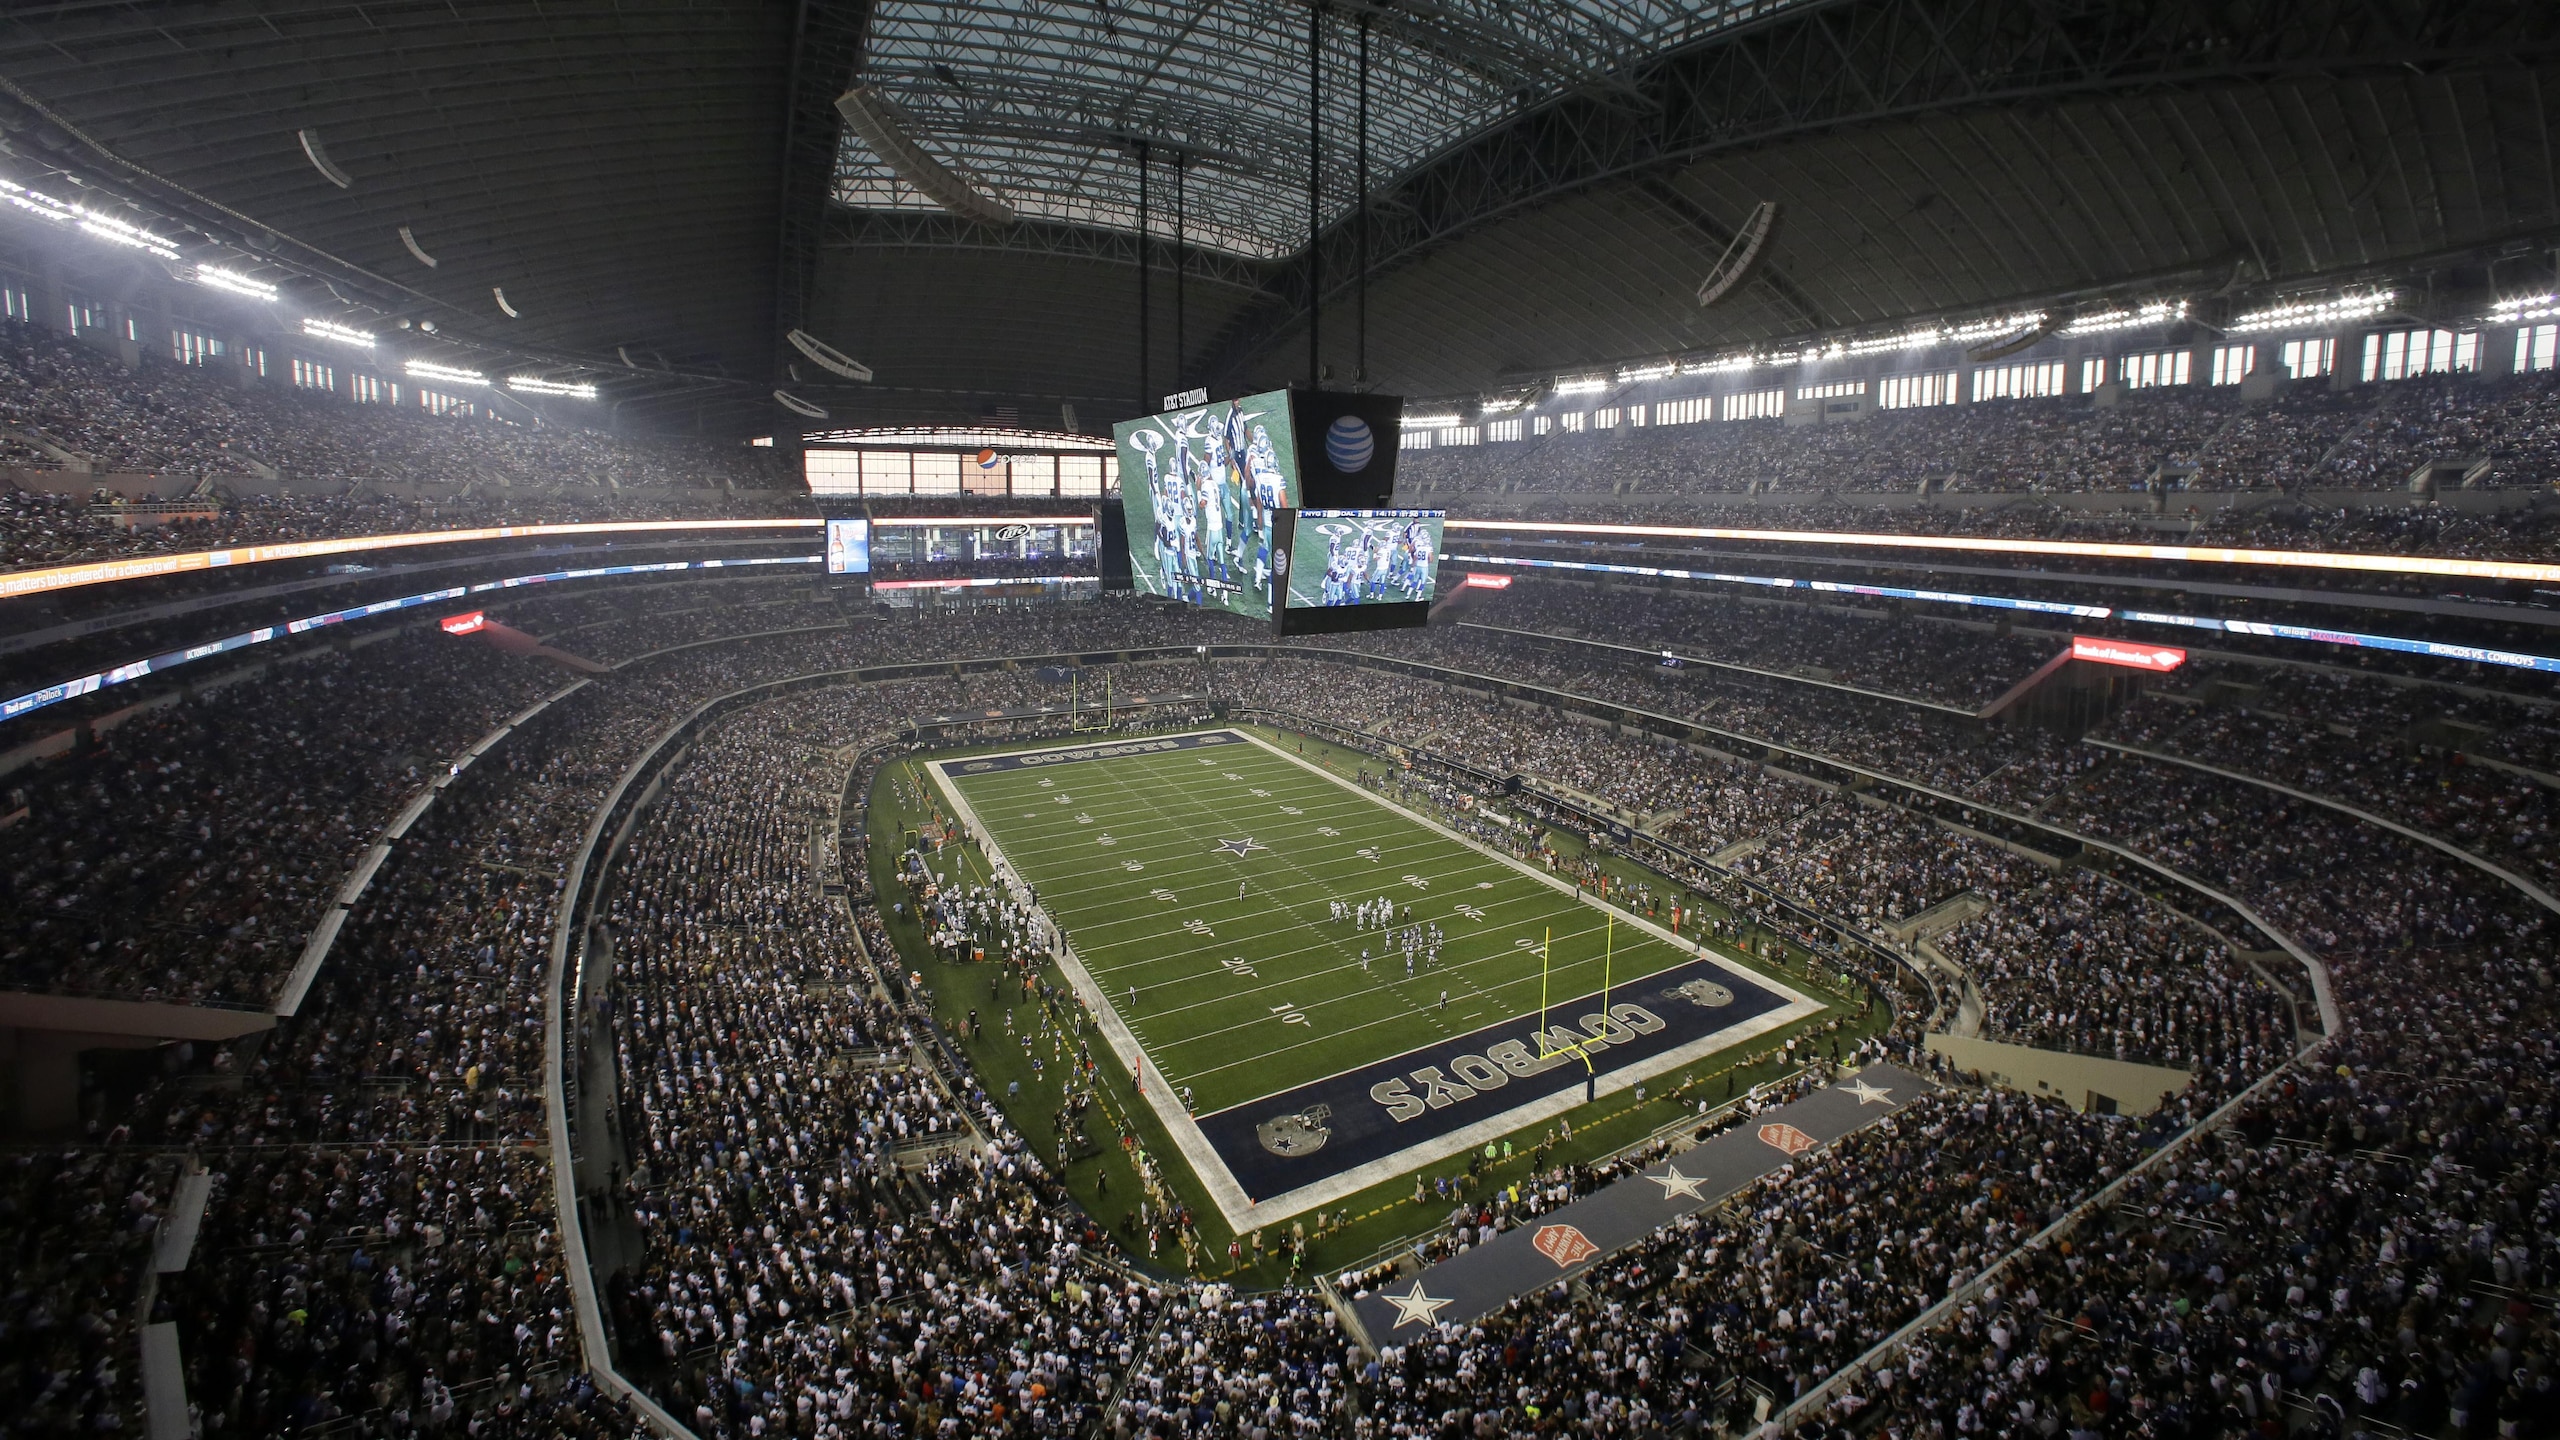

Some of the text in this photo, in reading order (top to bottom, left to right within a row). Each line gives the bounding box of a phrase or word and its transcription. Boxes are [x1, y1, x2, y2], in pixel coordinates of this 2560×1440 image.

[1163, 387, 1208, 411] AT&T STADIUM
[1167, 481, 1179, 504] 82
[1260, 484, 1275, 509] 68
[6, 578, 46, 593] matters
[47, 575, 56, 586] to
[58, 572, 69, 585] be
[70, 568, 104, 583] entered
[104, 566, 117, 579] for
[125, 562, 153, 576] chance
[153, 562, 161, 572] to
[162, 559, 177, 571] win!
[2136, 613, 2167, 624] OCTOBER
[2176, 616, 2194, 626] 2013
[2074, 644, 2152, 664] Bank of America
[2429, 644, 2536, 667] BRONCOS VS. COWBOYS
[1020, 740, 1179, 765] COWBOYS
[1183, 919, 1212, 935] 30
[1221, 956, 1254, 975] 20
[1269, 1002, 1305, 1024] 10
[1369, 1002, 1667, 1124] COWBOYS
[1543, 1228, 1560, 1252] ARMY
[1570, 1240, 1585, 1257] THE
